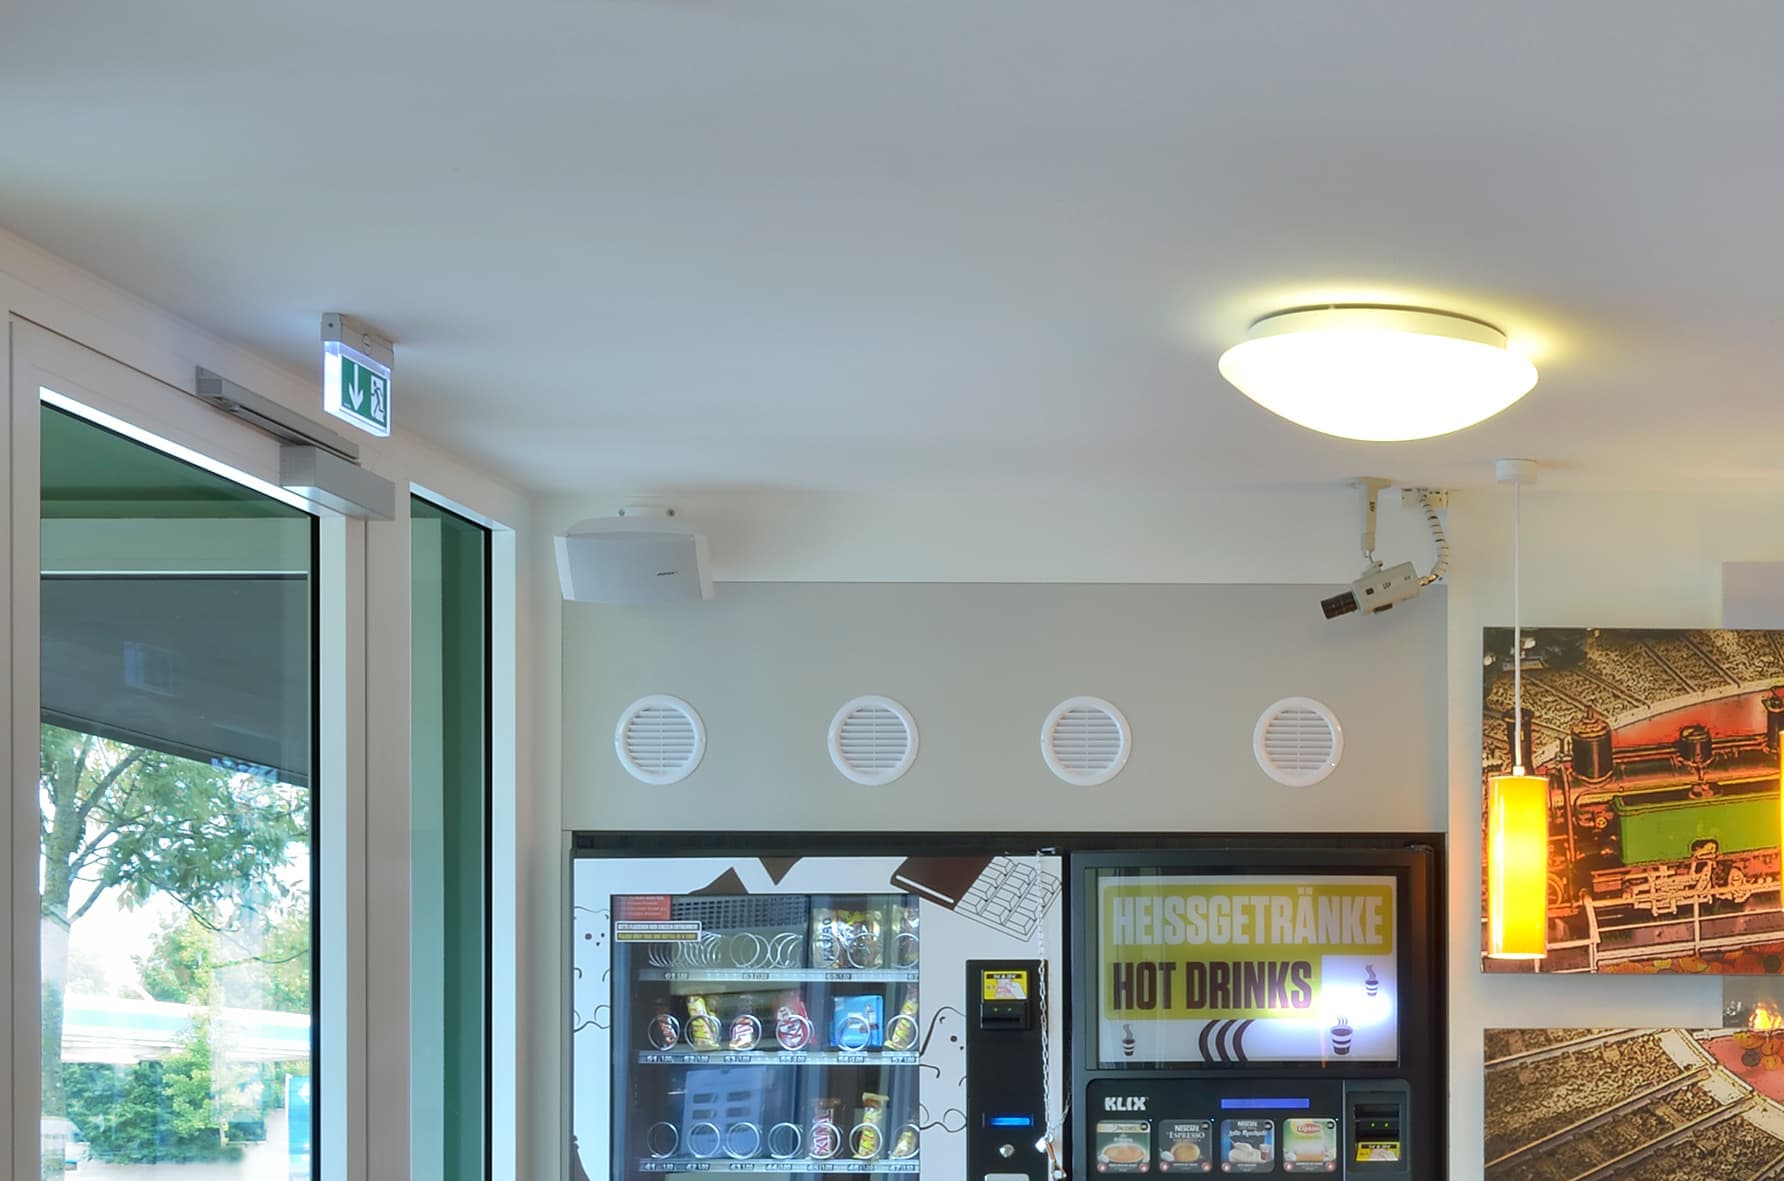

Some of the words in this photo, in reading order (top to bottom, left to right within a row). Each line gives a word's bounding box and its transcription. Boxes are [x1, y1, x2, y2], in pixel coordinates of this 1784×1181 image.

[1112, 887, 1383, 945] HEISSGETRÄNKE
[1112, 961, 1176, 1010] HOT
[1186, 960, 1312, 1010] DRINKS
[1104, 1097, 1146, 1111] KLIX
